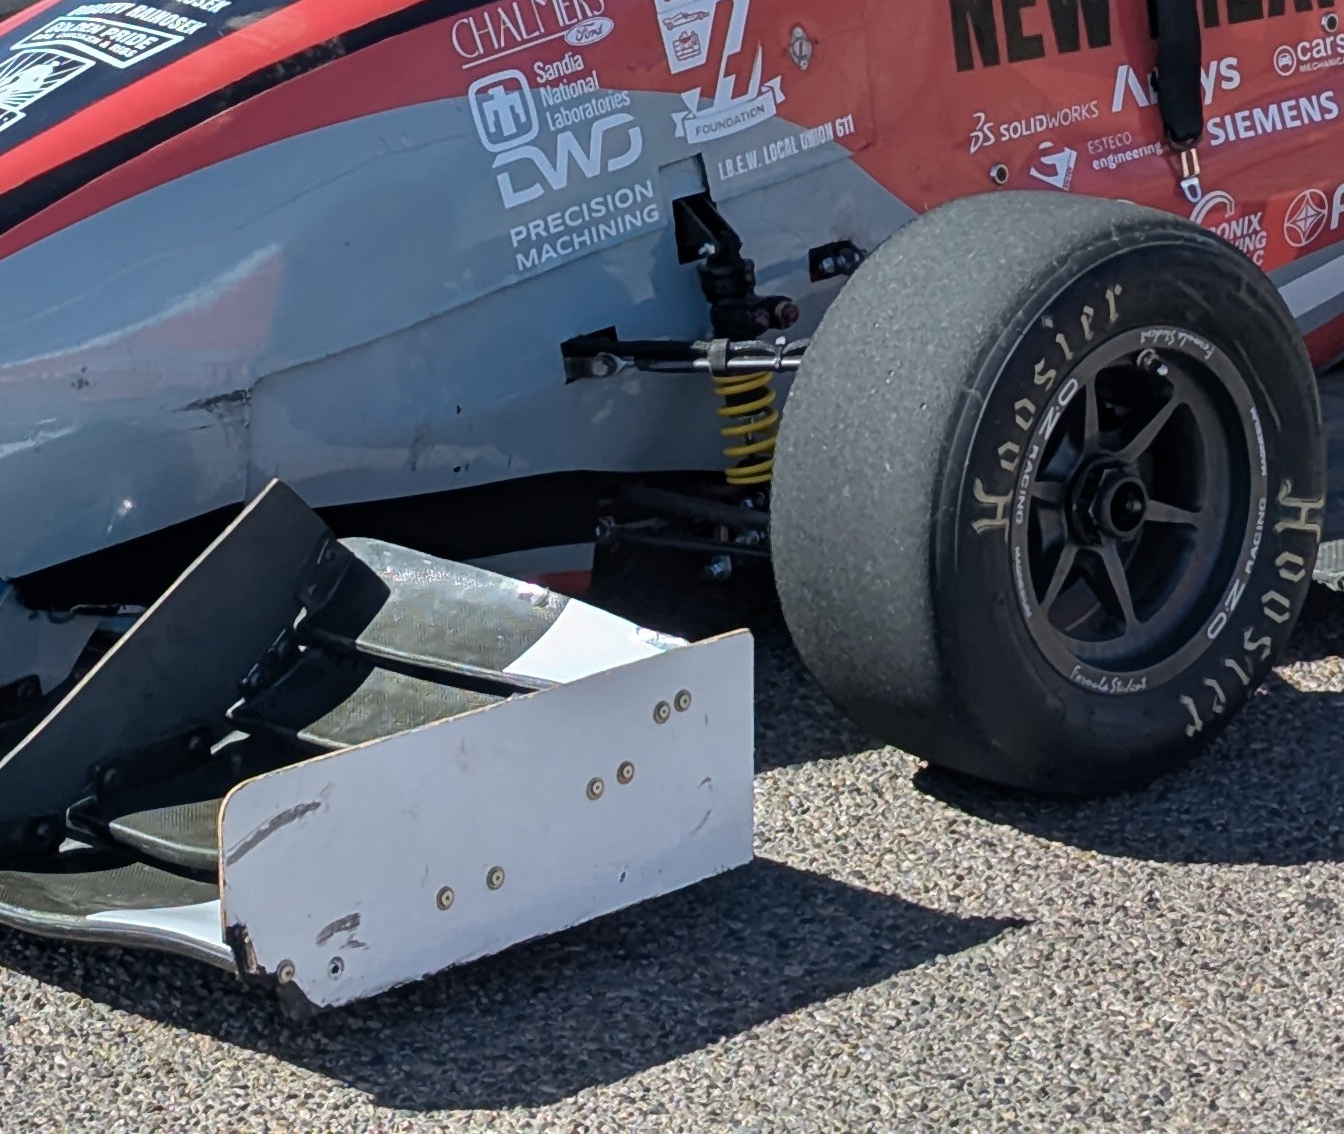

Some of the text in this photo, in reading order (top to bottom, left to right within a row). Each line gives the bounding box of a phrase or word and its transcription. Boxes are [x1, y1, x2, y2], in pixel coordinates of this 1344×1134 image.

[99, 26, 159, 50] PRIDE
[533, 51, 585, 84] Sandia
[540, 69, 600, 108] National
[545, 89, 631, 132] Laboratories
[694, 104, 766, 138] FOUNDATION
[1000, 100, 1099, 142] SOLIDWORKS
[1208, 91, 1340, 147] SIEMENS
[763, 135, 799, 164] LOCAL
[1087, 131, 1132, 155] ESTECO
[1092, 140, 1163, 171] engineering
[510, 179, 655, 247] PRECISION
[516, 203, 660, 272] MACHINING
[972, 283, 1123, 543] Hoosier
[1185, 479, 1325, 736] Hoosier
